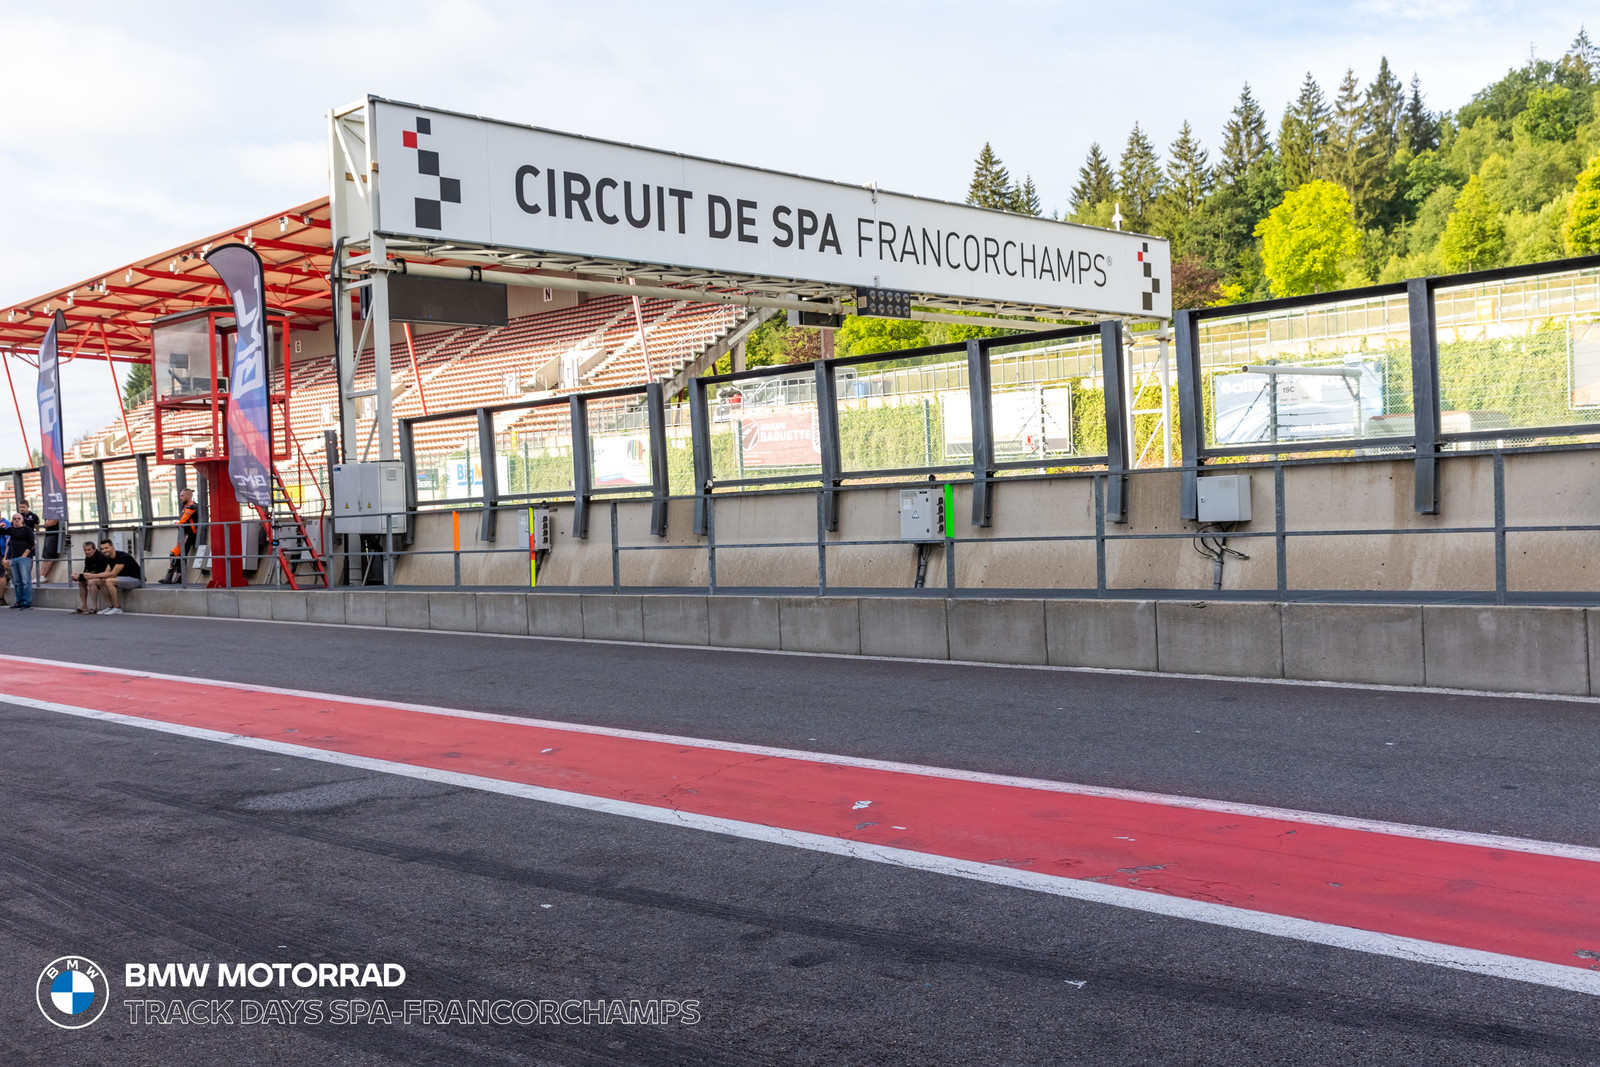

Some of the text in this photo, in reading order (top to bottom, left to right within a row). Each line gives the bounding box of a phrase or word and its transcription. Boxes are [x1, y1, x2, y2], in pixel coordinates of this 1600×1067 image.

[515, 164, 693, 234] CIRCUIT
[707, 193, 759, 244] DE
[772, 204, 842, 255] SPA
[760, 429, 812, 443] BAGUETTE
